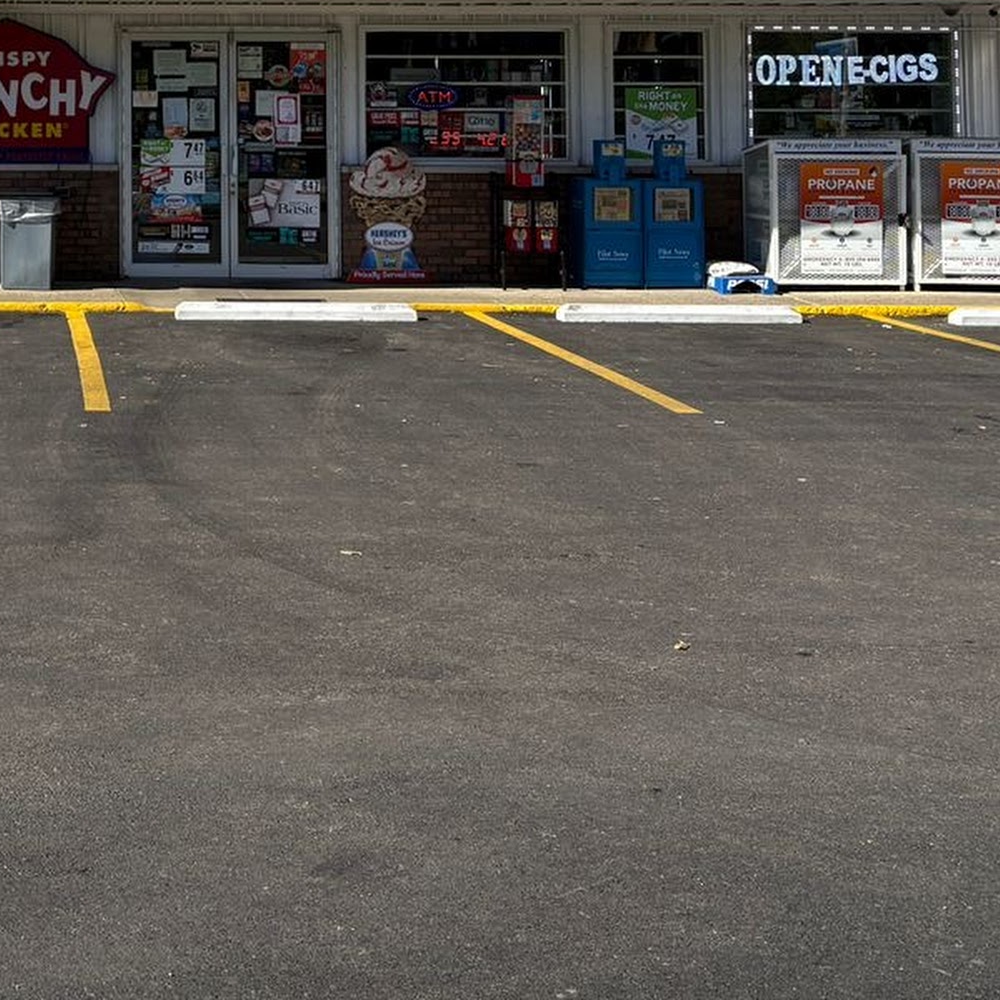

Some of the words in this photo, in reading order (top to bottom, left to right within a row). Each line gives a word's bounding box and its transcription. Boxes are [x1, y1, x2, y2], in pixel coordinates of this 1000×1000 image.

[755, 54, 844, 87] OPEN
[847, 53, 939, 84] E-CIGS
[417, 89, 452, 103] ATM
[638, 91, 671, 101] RIGHT
[648, 101, 689, 112] MONEY
[807, 178, 876, 190] PROPANE
[948, 178, 1000, 190] PROPA
[278, 203, 318, 215] Basic
